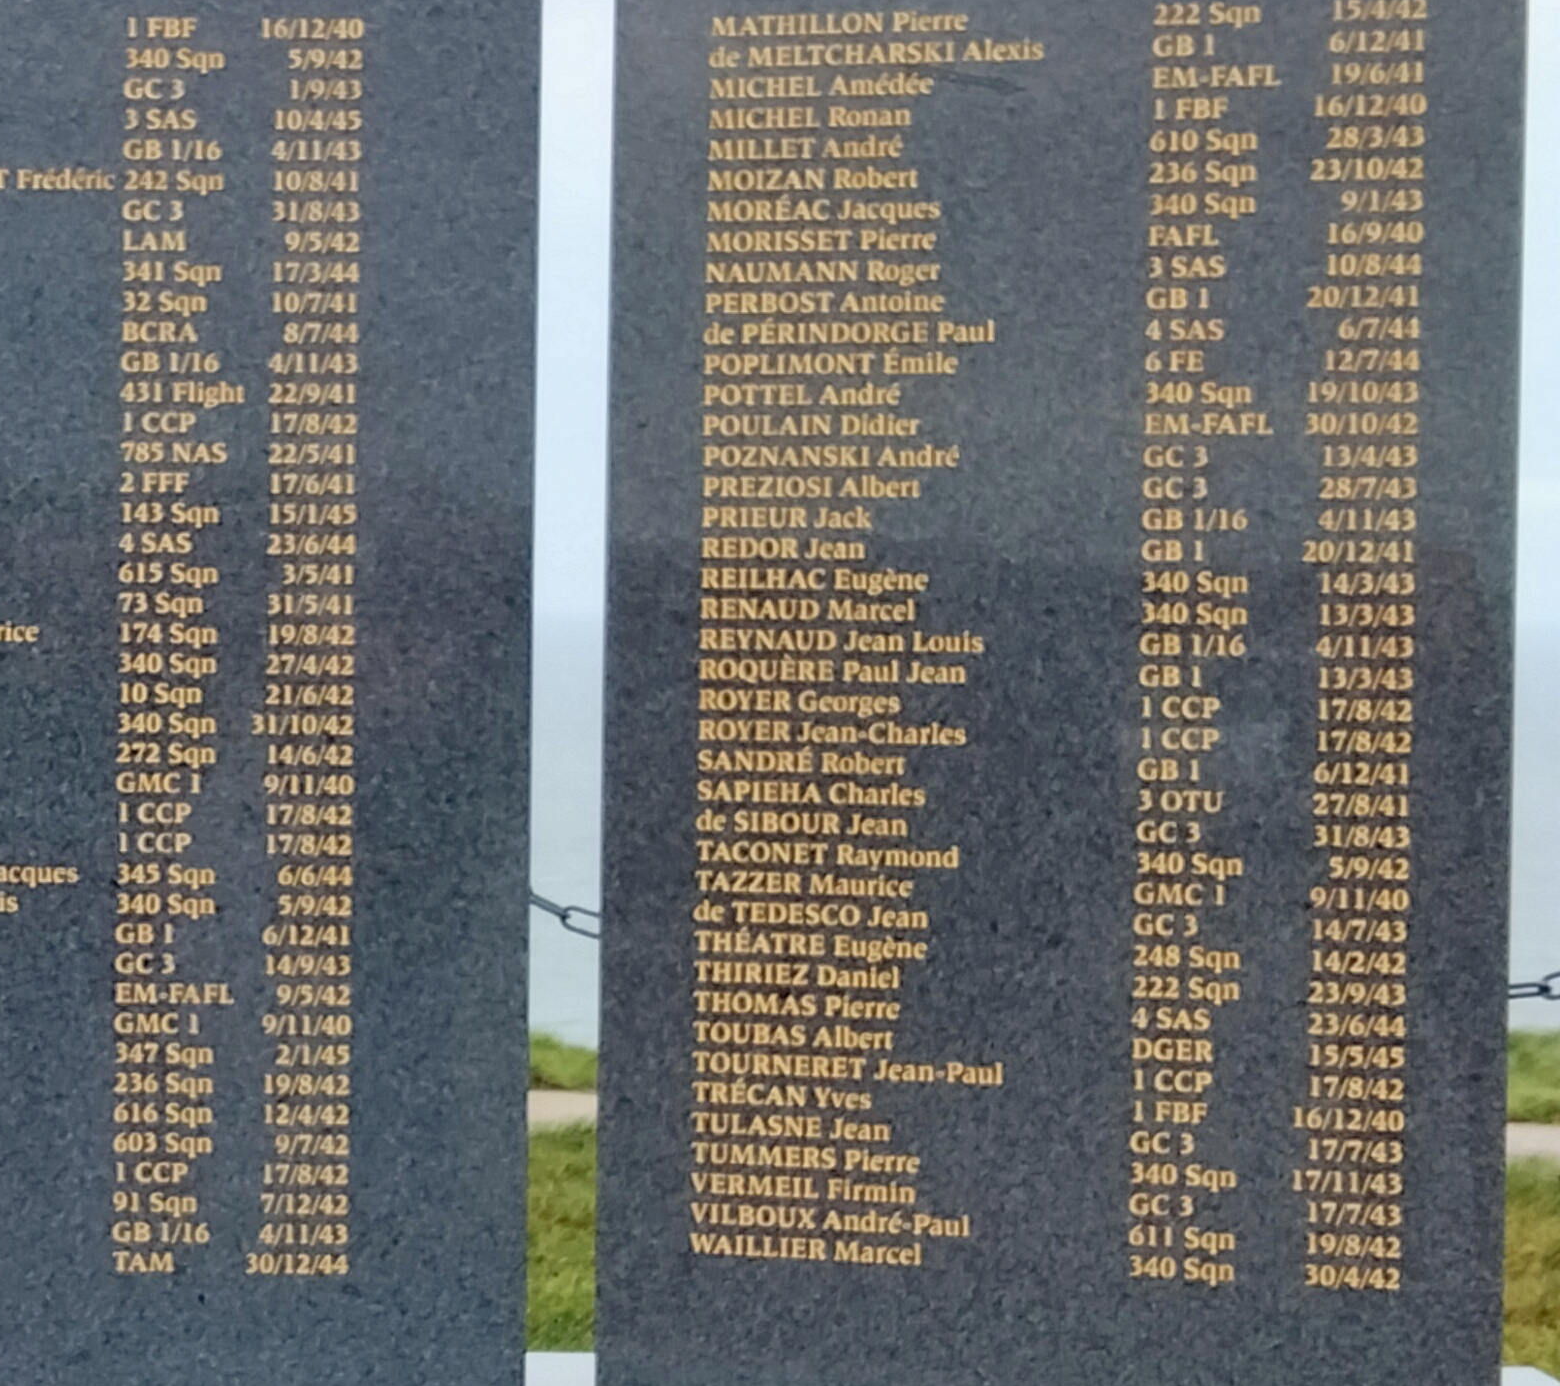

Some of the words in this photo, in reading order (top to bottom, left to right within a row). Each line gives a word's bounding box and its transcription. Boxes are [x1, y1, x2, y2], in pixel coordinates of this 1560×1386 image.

[129, 18, 137, 37] 1
[147, 17, 196, 38] FBF
[262, 18, 364, 39] 16/12/40
[712, 13, 882, 36] MATHILLON
[893, 12, 968, 32] Pierre
[1154, 3, 1200, 26] 222
[1209, 2, 1261, 28] Sqn
[126, 109, 138, 129] 3
[146, 108, 196, 130] SAS
[276, 110, 362, 130] 10/4/45
[708, 169, 825, 191] MOIZAN
[834, 166, 917, 189] Robert
[1149, 162, 1198, 183] 236
[1205, 161, 1257, 187] Sqn
[1311, 157, 1423, 181] 23/10/42
[707, 229, 852, 253] MORISSET
[861, 229, 936, 250] Pierre
[1149, 224, 1219, 246] FAFL
[1328, 221, 1424, 244] 16/9/40
[124, 291, 151, 312] 32
[159, 291, 207, 317] Sqn
[273, 292, 356, 313] 10/7/41
[120, 382, 162, 402] 431
[173, 381, 242, 408] Flight
[269, 383, 355, 404] 22/9/41
[703, 384, 812, 406] POTTEL
[820, 382, 900, 405] André
[1147, 381, 1193, 404] 340
[1200, 382, 1252, 409] Sqn
[1309, 381, 1419, 403] 19/10/43
[120, 472, 134, 492] 2
[142, 472, 188, 493] FFF
[271, 473, 354, 495] 17/6/41
[702, 506, 807, 529] PRIEUR
[814, 506, 872, 529] Jack
[1142, 508, 1183, 530] GB
[1195, 509, 1248, 531] 1/16
[1319, 508, 1416, 531] 4/11/43
[121, 683, 148, 703] 10
[154, 682, 202, 709] Sqn
[265, 684, 353, 706] 21/6/42
[697, 779, 822, 803] SAPIEHA
[828, 782, 926, 807] Charles
[1138, 789, 1153, 811] 3
[1160, 790, 1223, 813] OTU
[1313, 792, 1408, 817] 27/8/41
[118, 863, 160, 884] 345
[167, 864, 215, 890] Sqn
[278, 865, 353, 886] 6/6/44
[116, 1042, 158, 1063] 347
[166, 1043, 213, 1069] Sqn
[276, 1044, 350, 1066] 2/1/45
[693, 1021, 806, 1047] TOUBAS
[813, 1025, 893, 1050] Albert
[1132, 1037, 1213, 1062] DGER
[1310, 1044, 1405, 1069] 15/5/45
[113, 1251, 174, 1272] TAM
[246, 1253, 349, 1275] 30/12/44
[690, 1232, 827, 1260] WAILLIER
[834, 1240, 921, 1266] Marcel
[1130, 1255, 1177, 1278] 340
[1183, 1257, 1235, 1286] Sqn
[1305, 1264, 1400, 1290] 30/4/42
